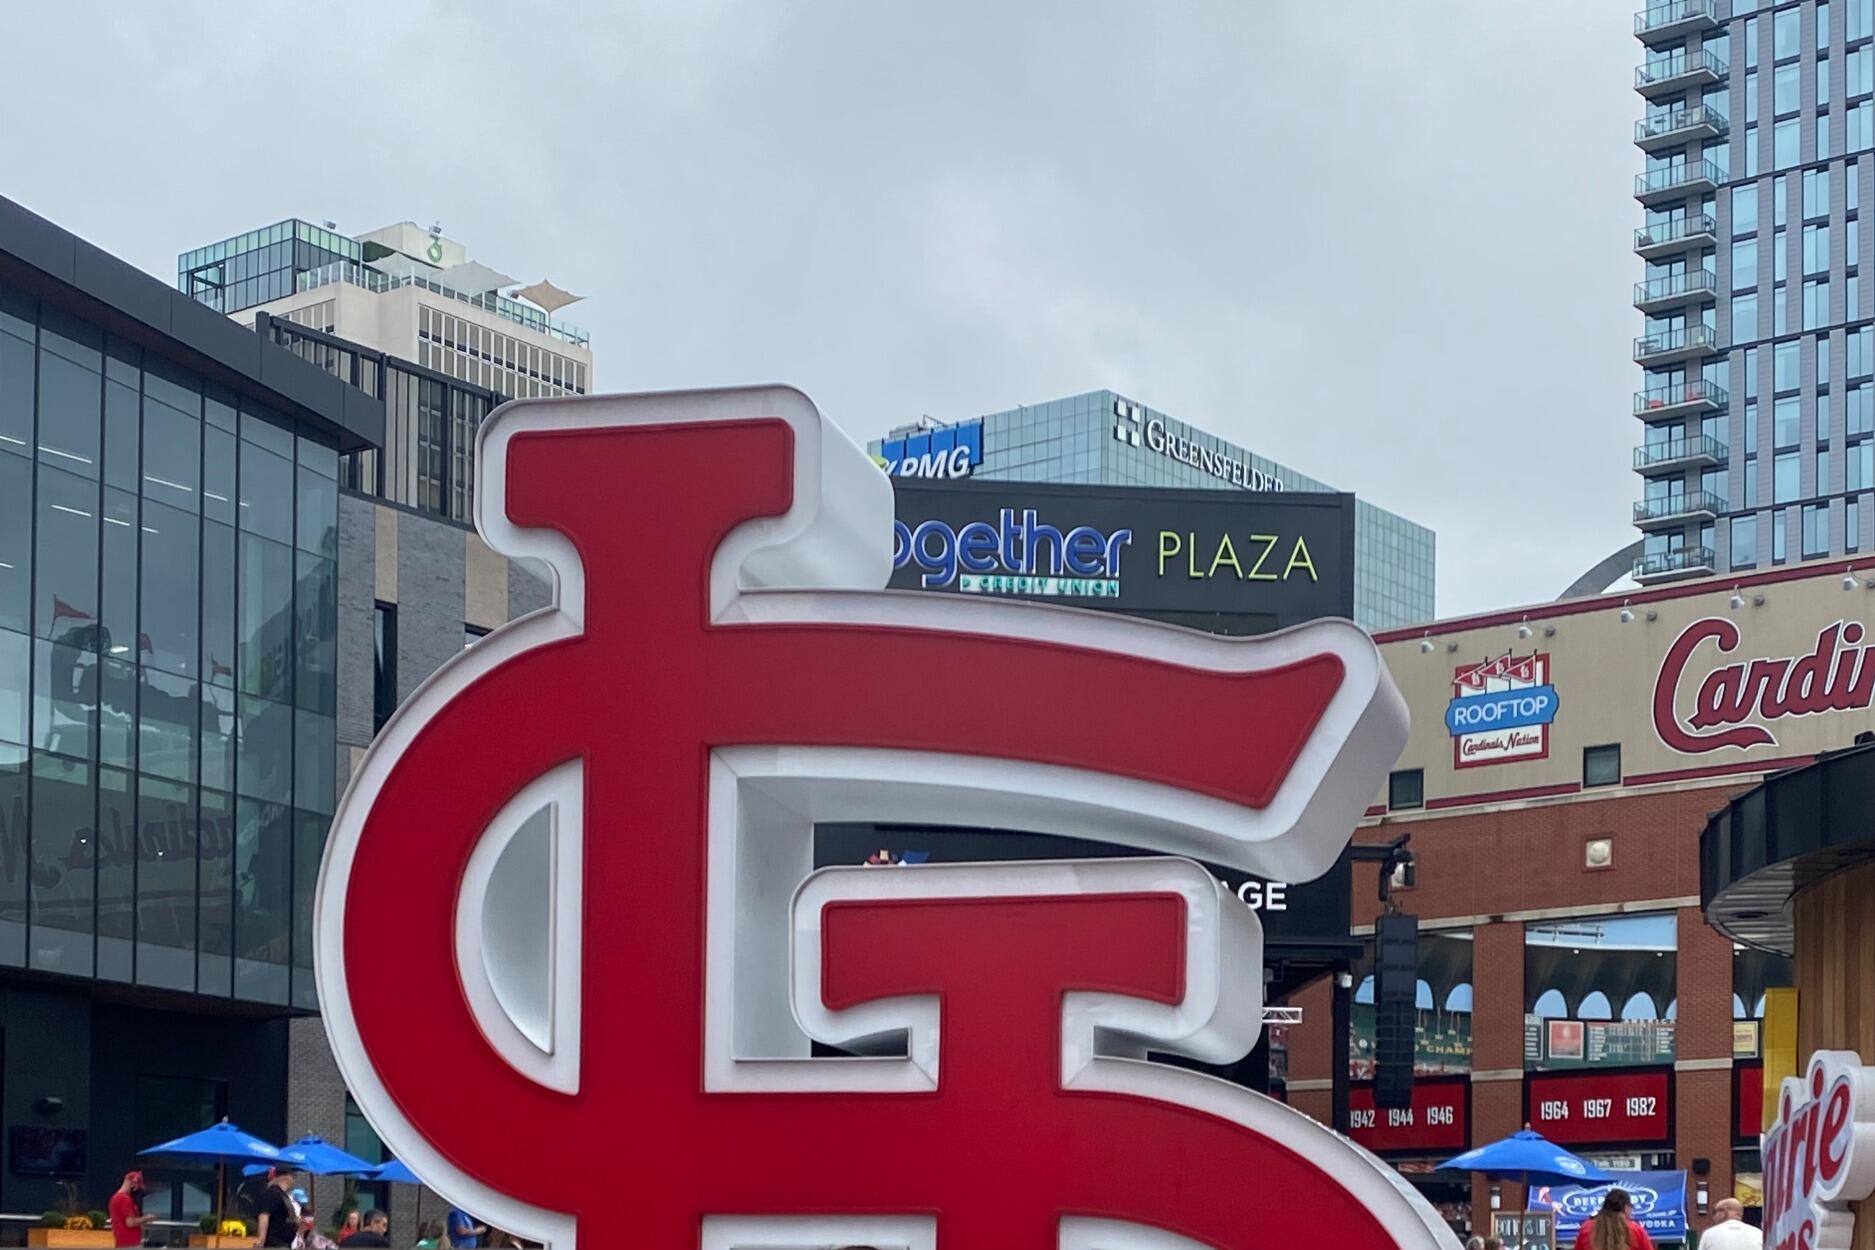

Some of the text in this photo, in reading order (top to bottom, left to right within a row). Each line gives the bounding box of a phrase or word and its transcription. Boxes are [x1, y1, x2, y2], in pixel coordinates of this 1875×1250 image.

[1158, 530, 1319, 581] PLAZA
[980, 575, 1117, 597] CREDIT UNION
[1454, 695, 1548, 726] ROOFTOP
[1463, 732, 1540, 756] Cardinals Nation
[1222, 881, 1288, 911] GE
[1350, 1105, 1454, 1128] 1942 1944 1946
[1541, 1096, 1656, 1120] 1964 1967 1982
[1638, 1219, 1676, 1229] VODKA
